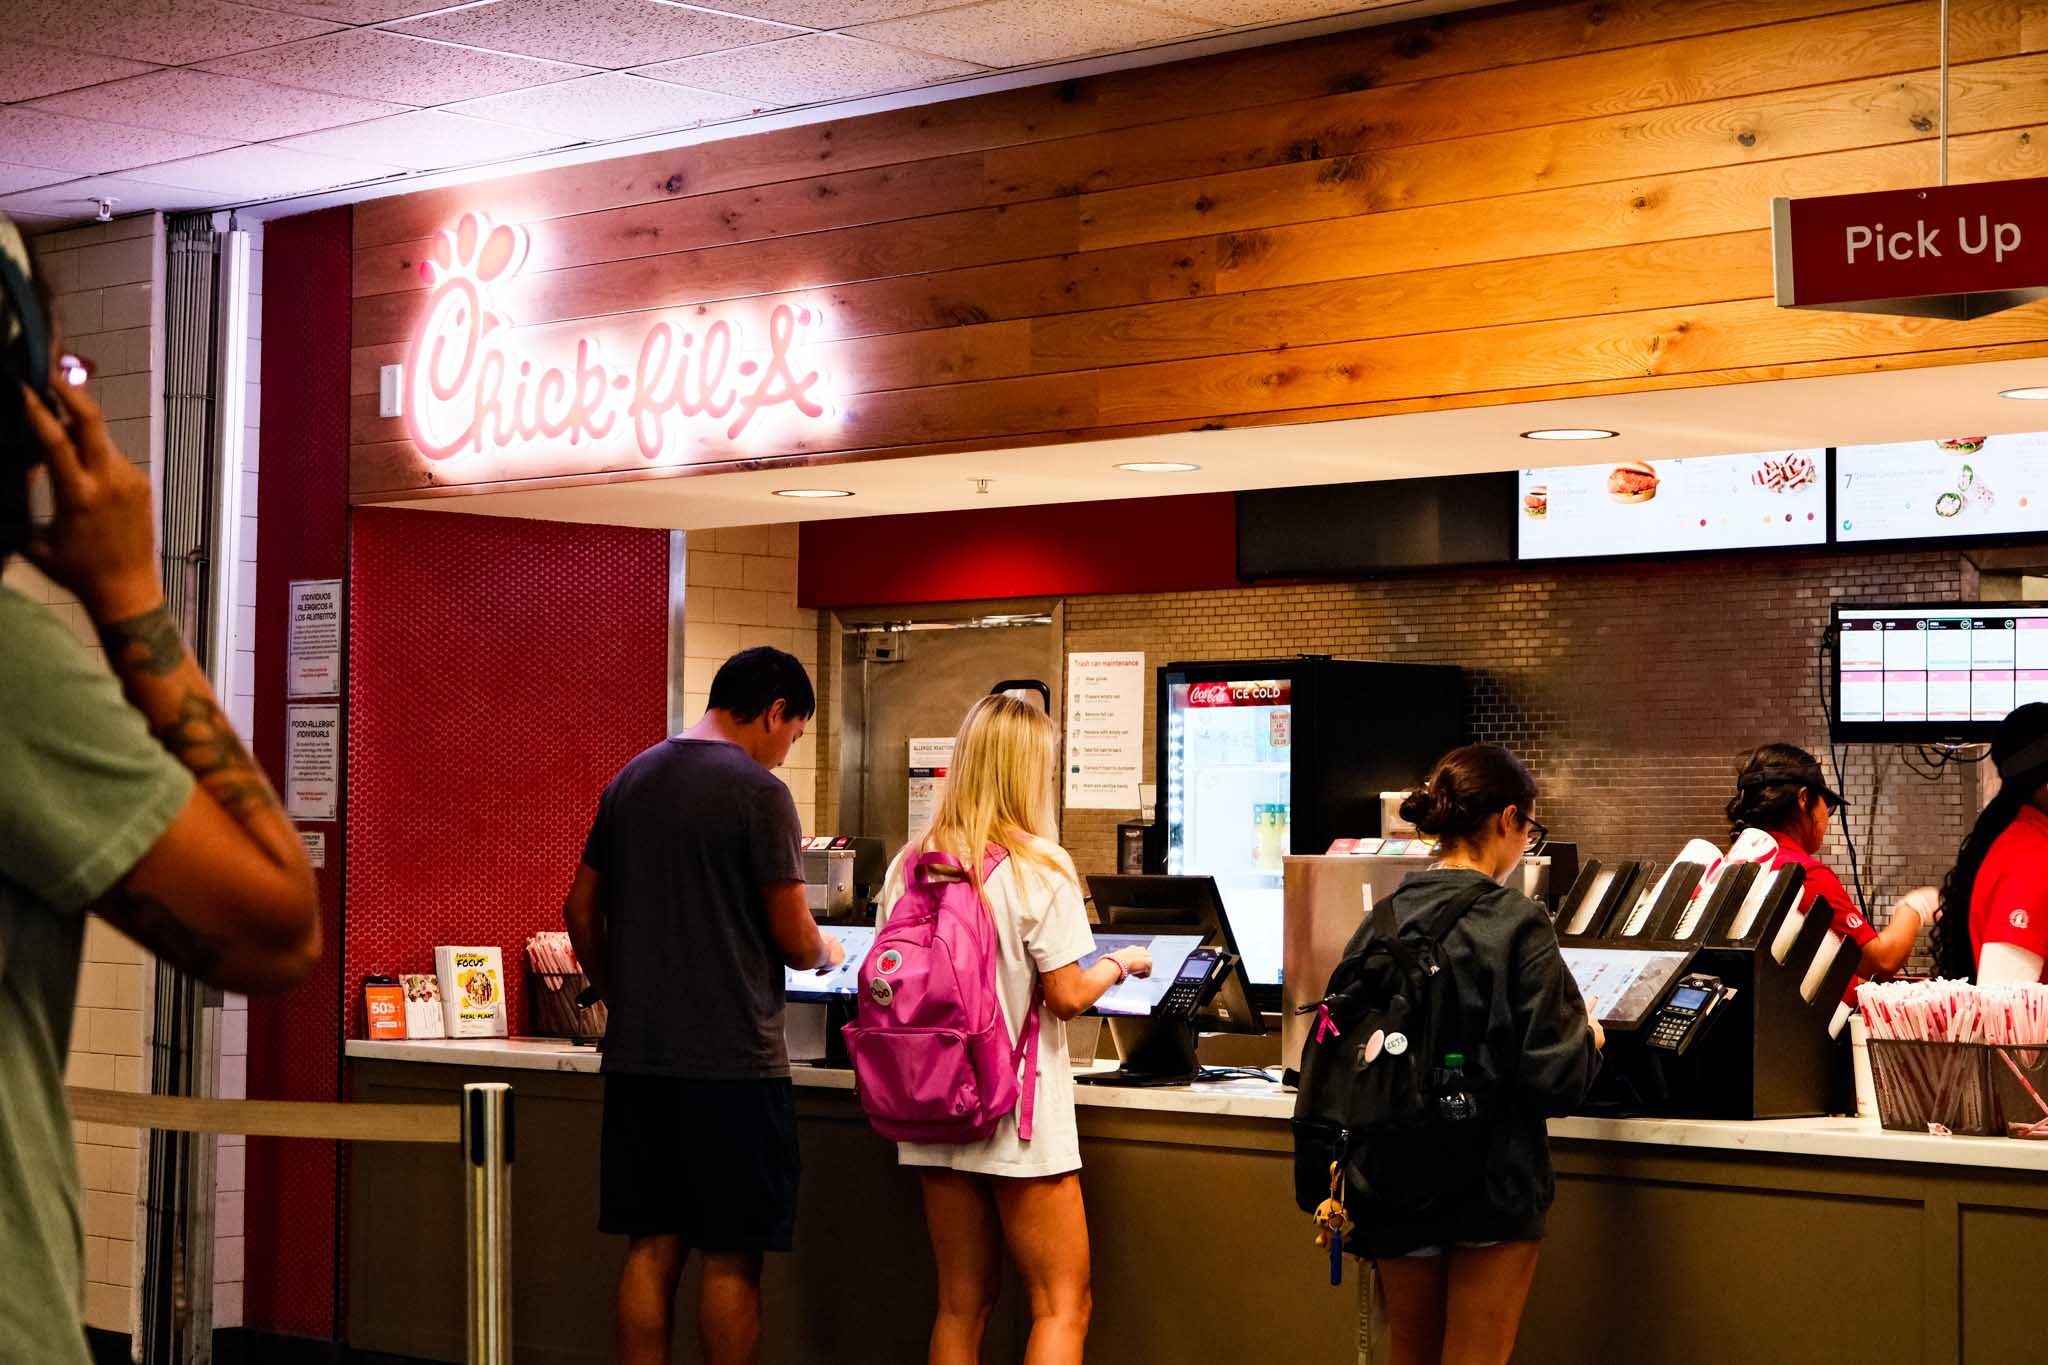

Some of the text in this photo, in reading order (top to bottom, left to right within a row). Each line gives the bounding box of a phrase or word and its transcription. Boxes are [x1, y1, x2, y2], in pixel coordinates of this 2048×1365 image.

[1846, 215, 2022, 264] Pick Up
[1232, 687, 1281, 700] ICE COLD
[291, 720, 336, 728] FOOD-ALLERGIC
[456, 958, 485, 967] FOCUS
